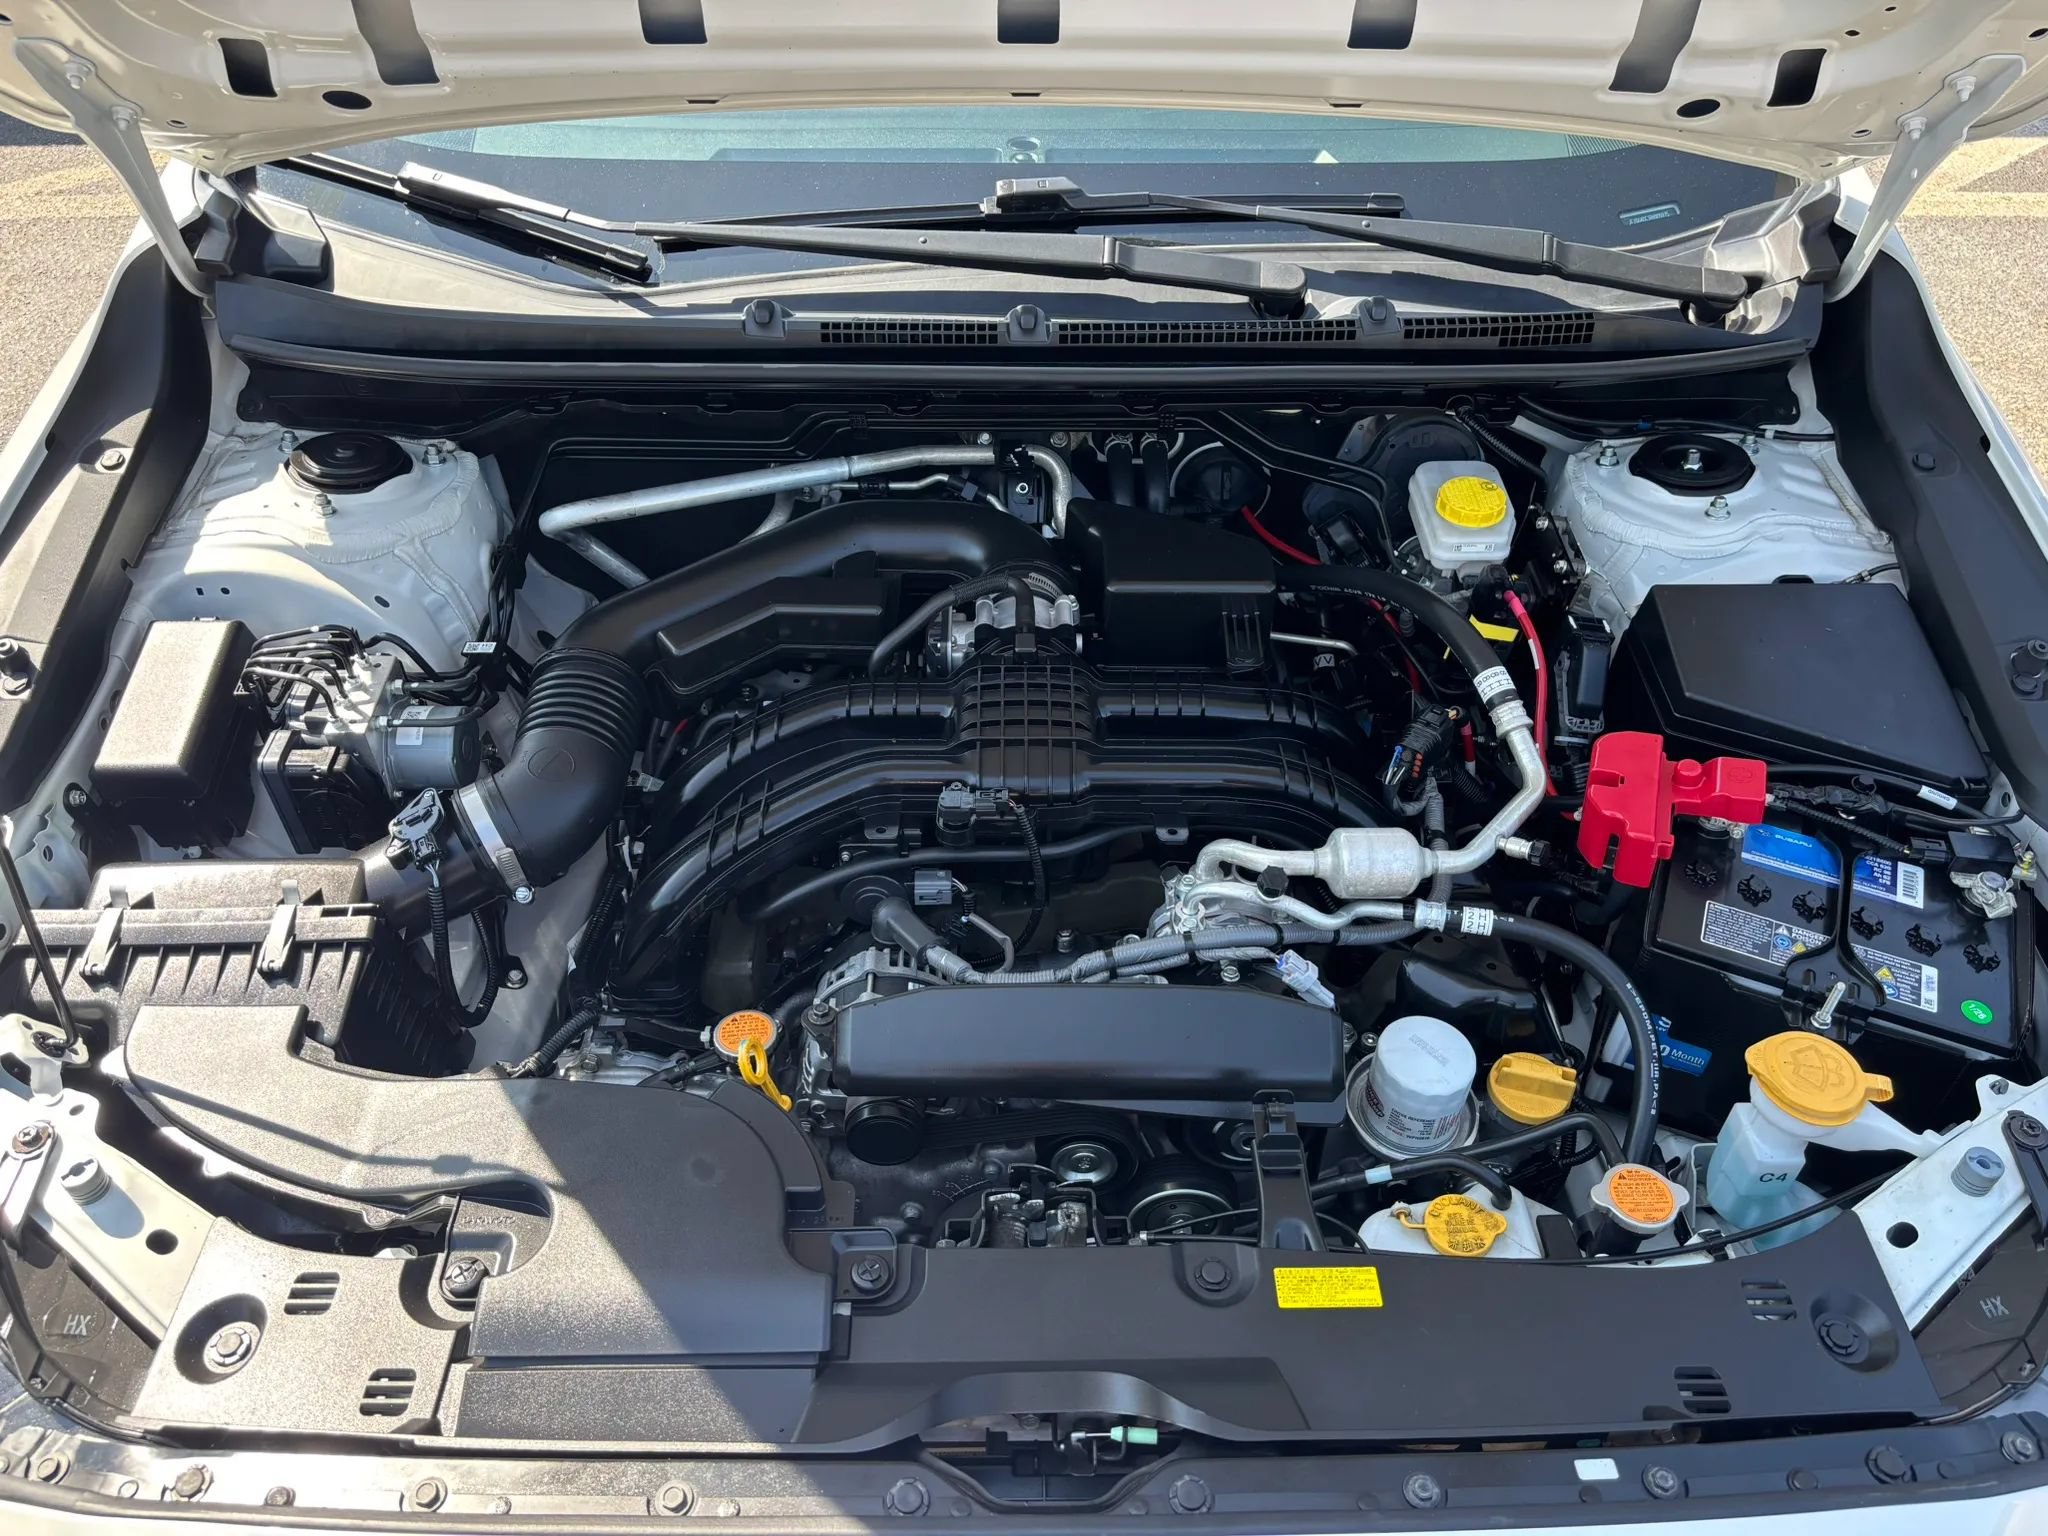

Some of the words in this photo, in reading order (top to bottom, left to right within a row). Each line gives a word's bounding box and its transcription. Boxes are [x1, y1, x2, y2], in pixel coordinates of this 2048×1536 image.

[1775, 834, 1812, 847] SUBARU
[1791, 933, 1822, 946] POISON
[1968, 1003, 1987, 1020] 1/26
[1671, 1048, 1705, 1065] Month
[1759, 1172, 1788, 1183] C4
[1429, 1196, 1485, 1217] COOLANT
[1979, 1295, 2010, 1319] HX
[63, 1313, 91, 1336] HX
